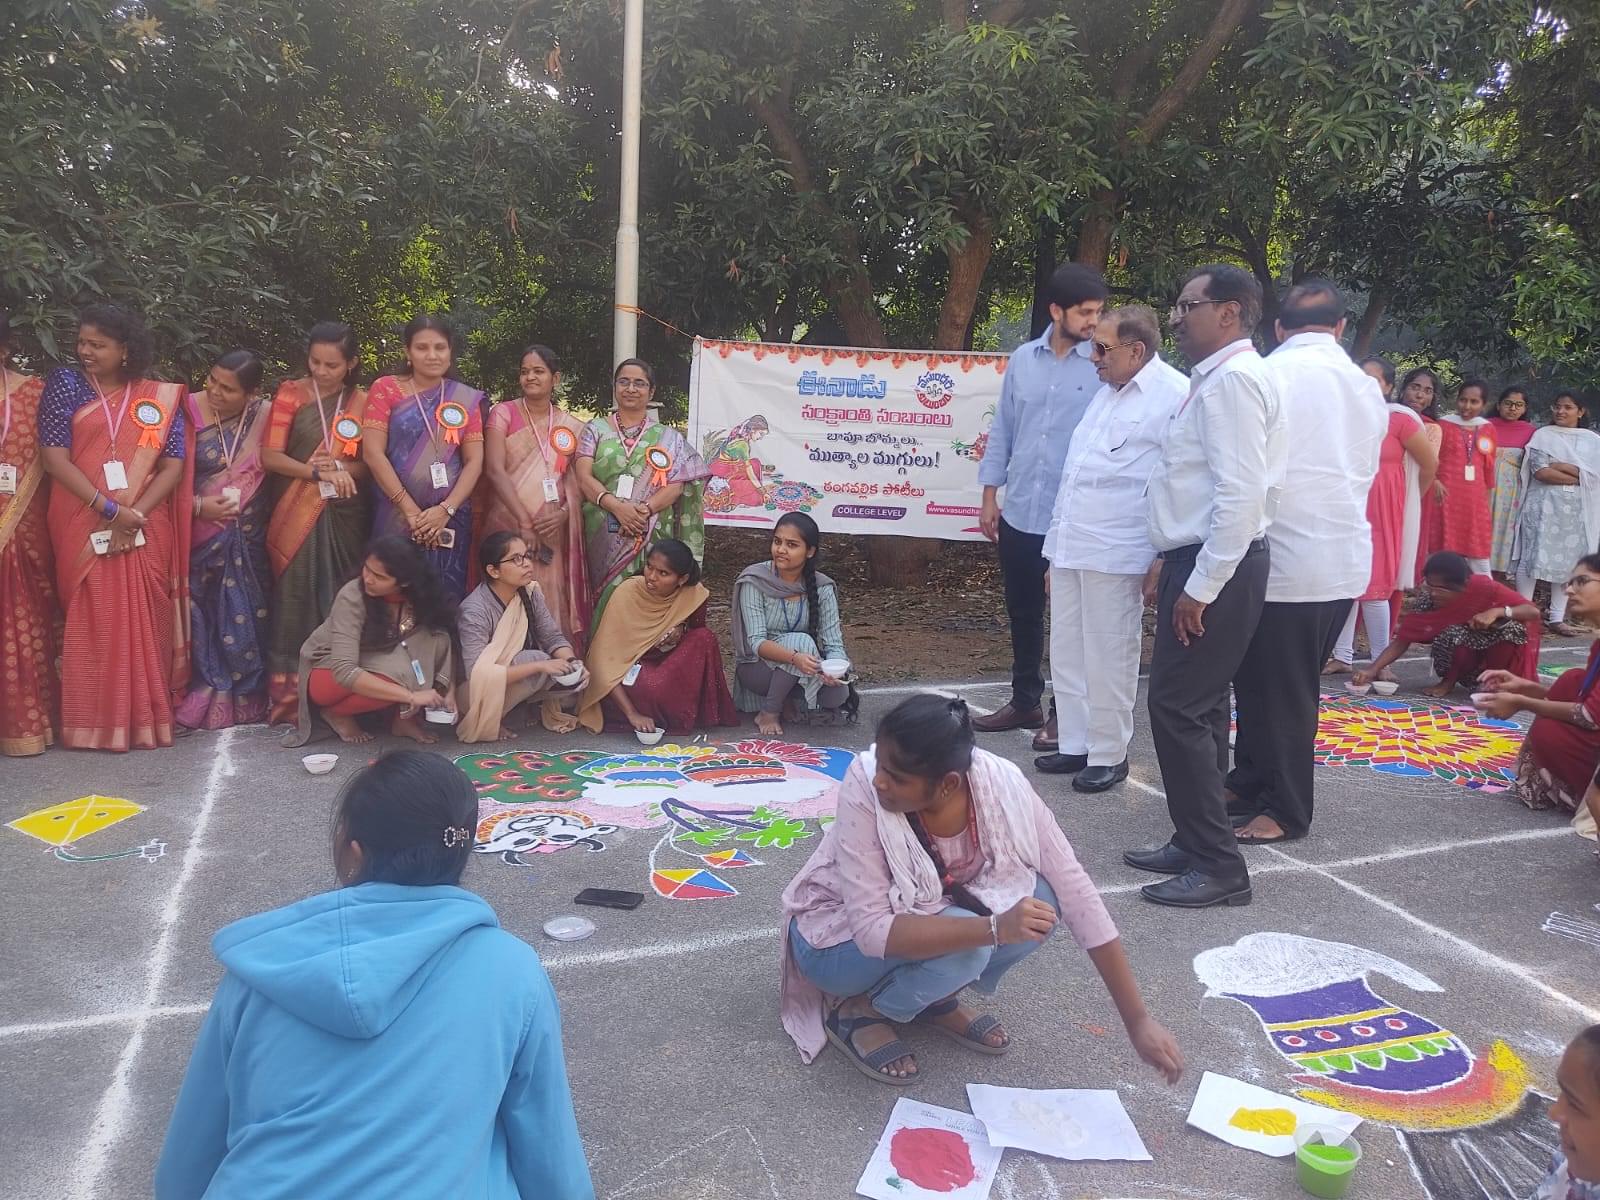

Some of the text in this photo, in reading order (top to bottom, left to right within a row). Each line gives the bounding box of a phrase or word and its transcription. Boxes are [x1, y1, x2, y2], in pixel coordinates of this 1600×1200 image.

[797, 371, 887, 399] ఈనాడు
[916, 371, 955, 390] వసుంధర
[801, 404, 953, 428] సంక్రాంతి సంబరాలు
[882, 480, 925, 498] పోటీలు
[837, 506, 904, 518] COLLEGE LEVEL
[927, 506, 981, 516] www.vasundha
